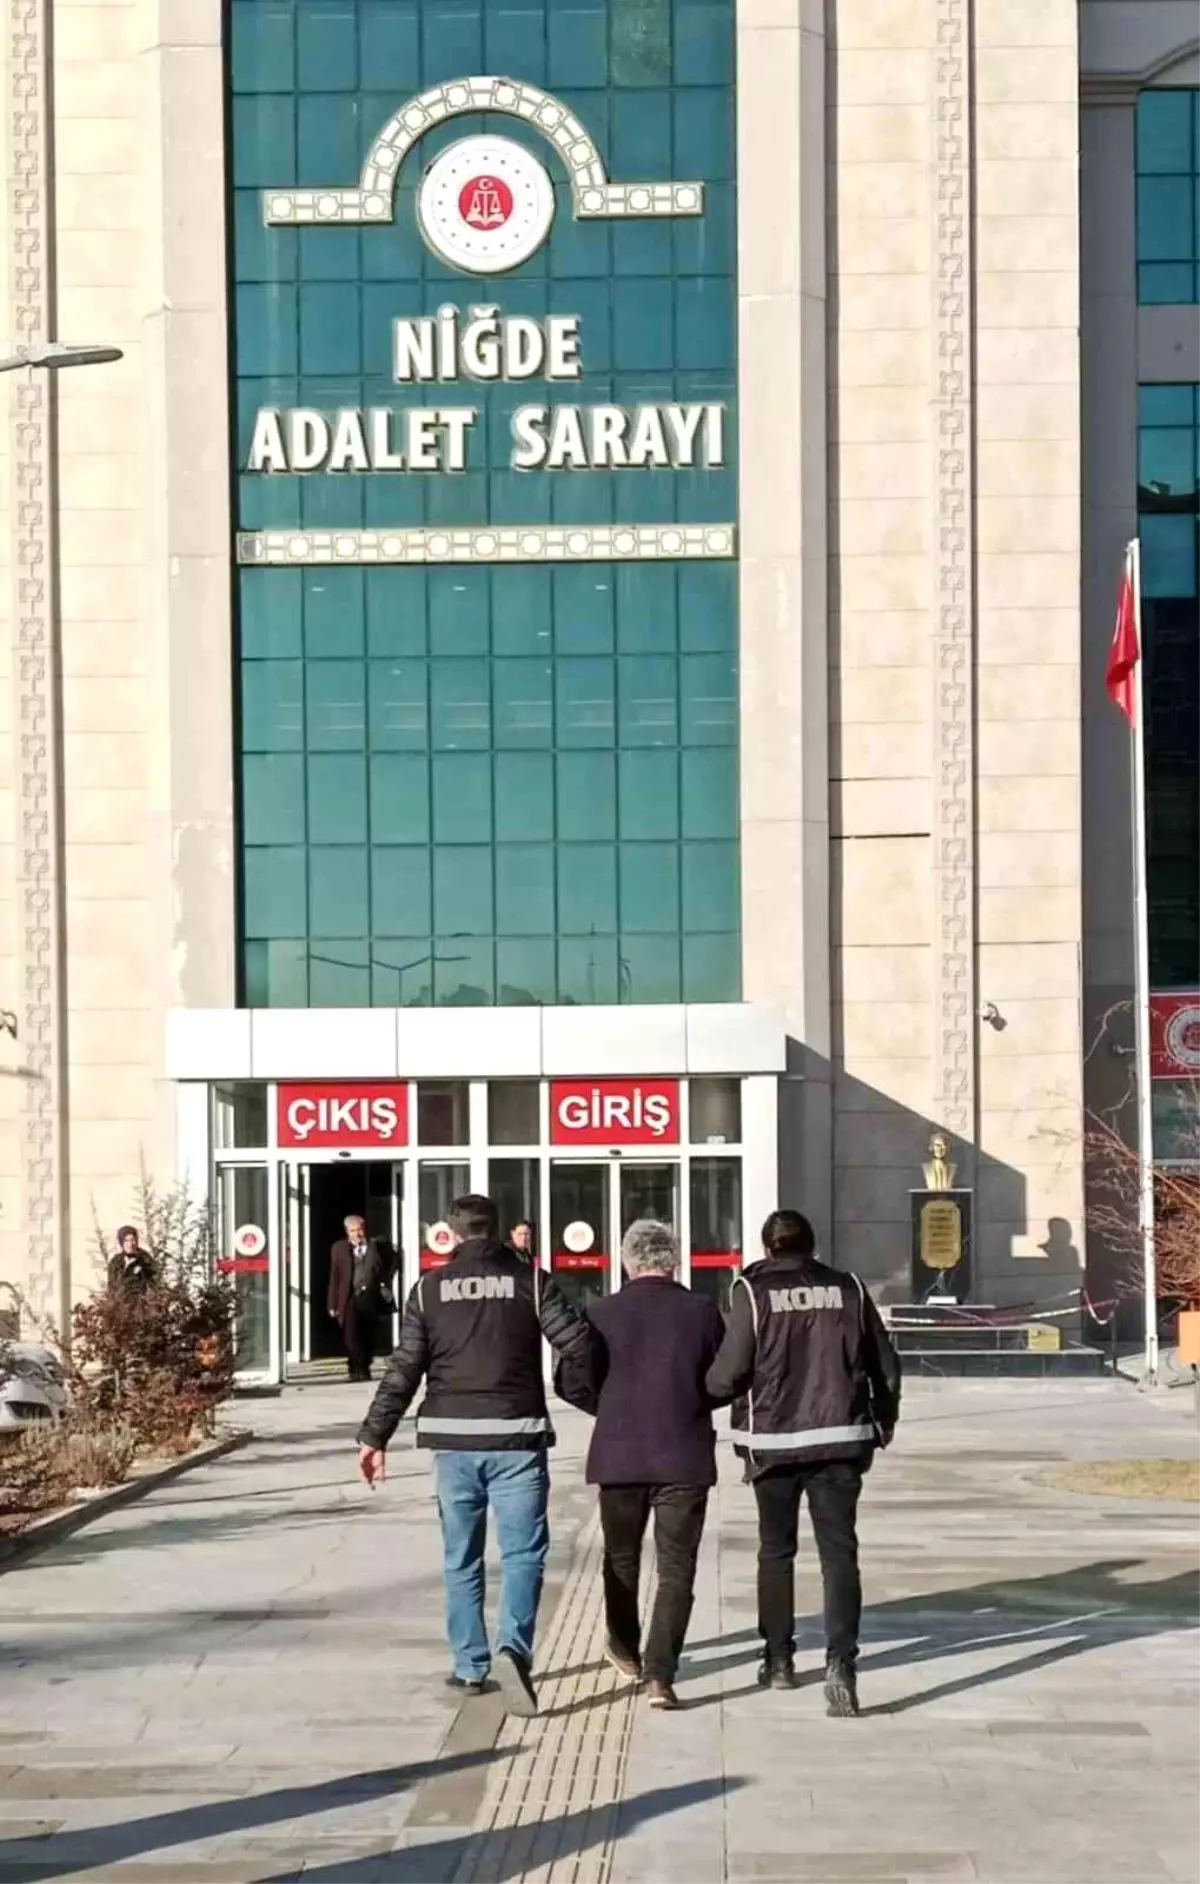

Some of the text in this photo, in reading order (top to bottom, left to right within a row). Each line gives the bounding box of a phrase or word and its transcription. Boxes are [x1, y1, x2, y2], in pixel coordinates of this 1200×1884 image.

[394, 303, 582, 381] NİĞDE
[248, 403, 725, 472] ADALET SARAYI
[287, 1097, 398, 1140] ÇIKIŞ
[558, 1087, 670, 1137] GİRİŞ
[440, 1275, 515, 1302] KOM
[768, 1286, 844, 1313] KOM
